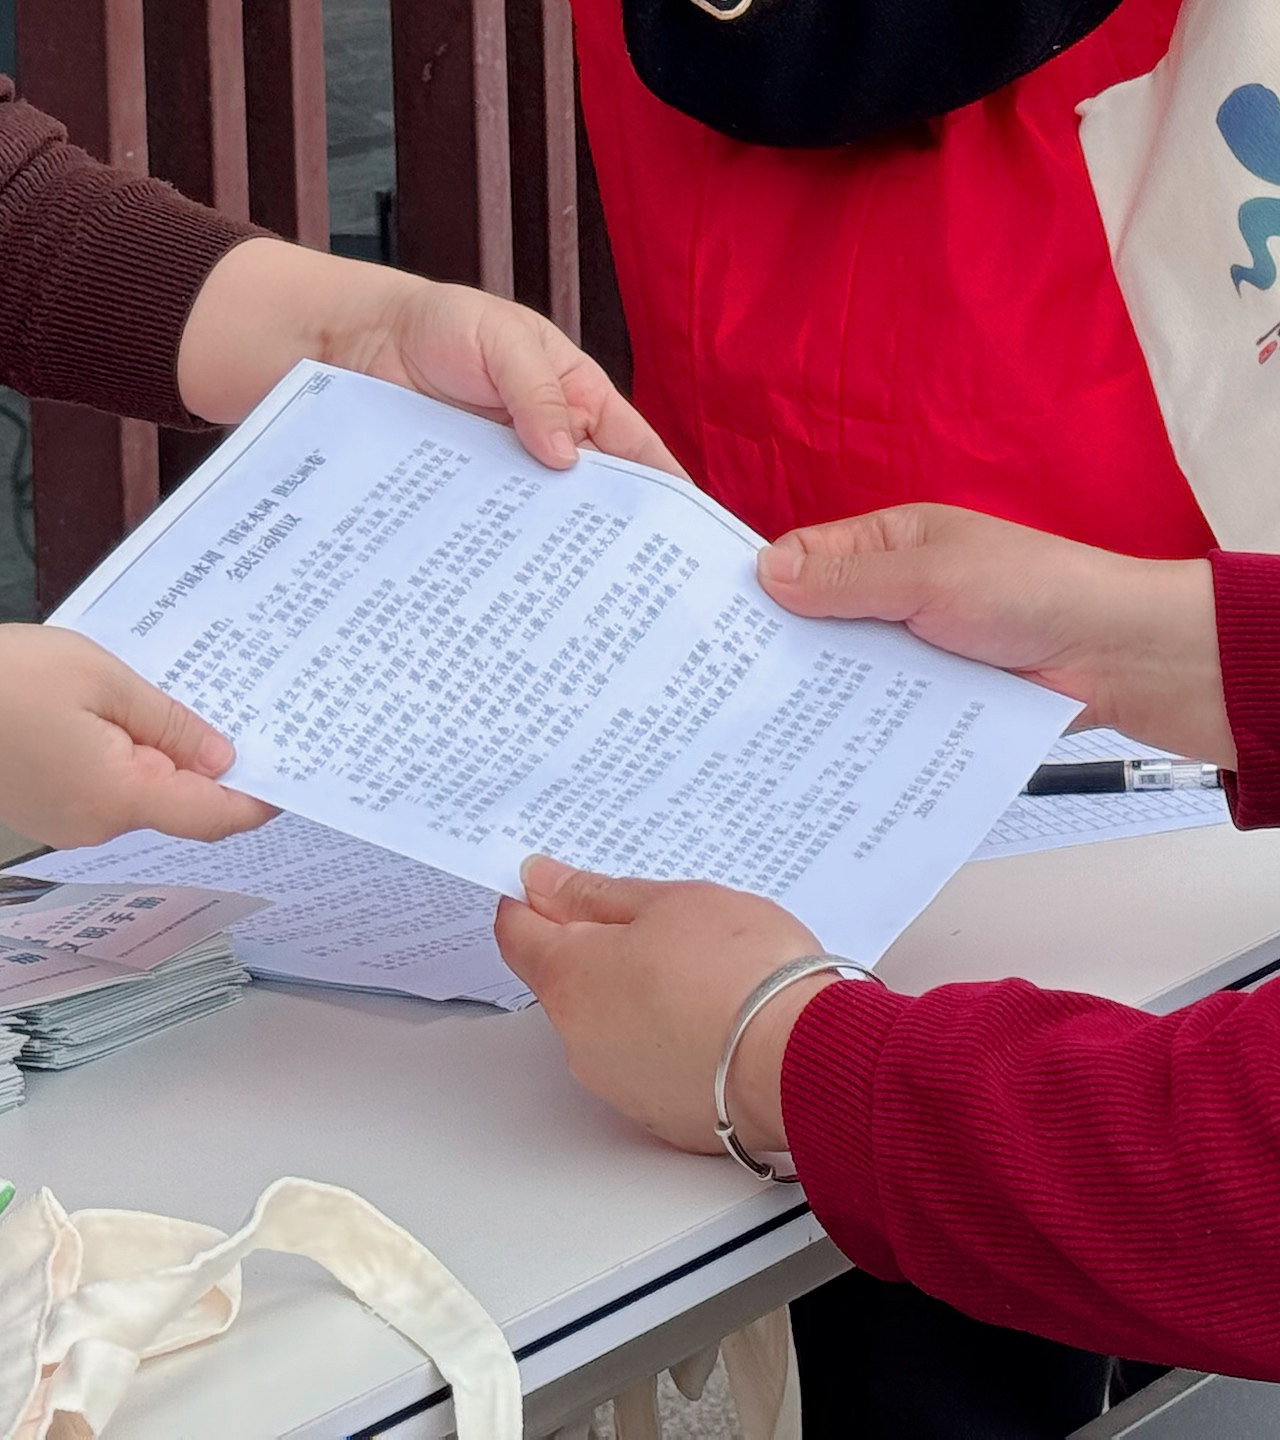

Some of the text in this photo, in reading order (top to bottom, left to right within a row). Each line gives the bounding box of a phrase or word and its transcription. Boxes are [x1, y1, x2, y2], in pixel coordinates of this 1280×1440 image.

[219, 510, 304, 584] 全民行动倡议
